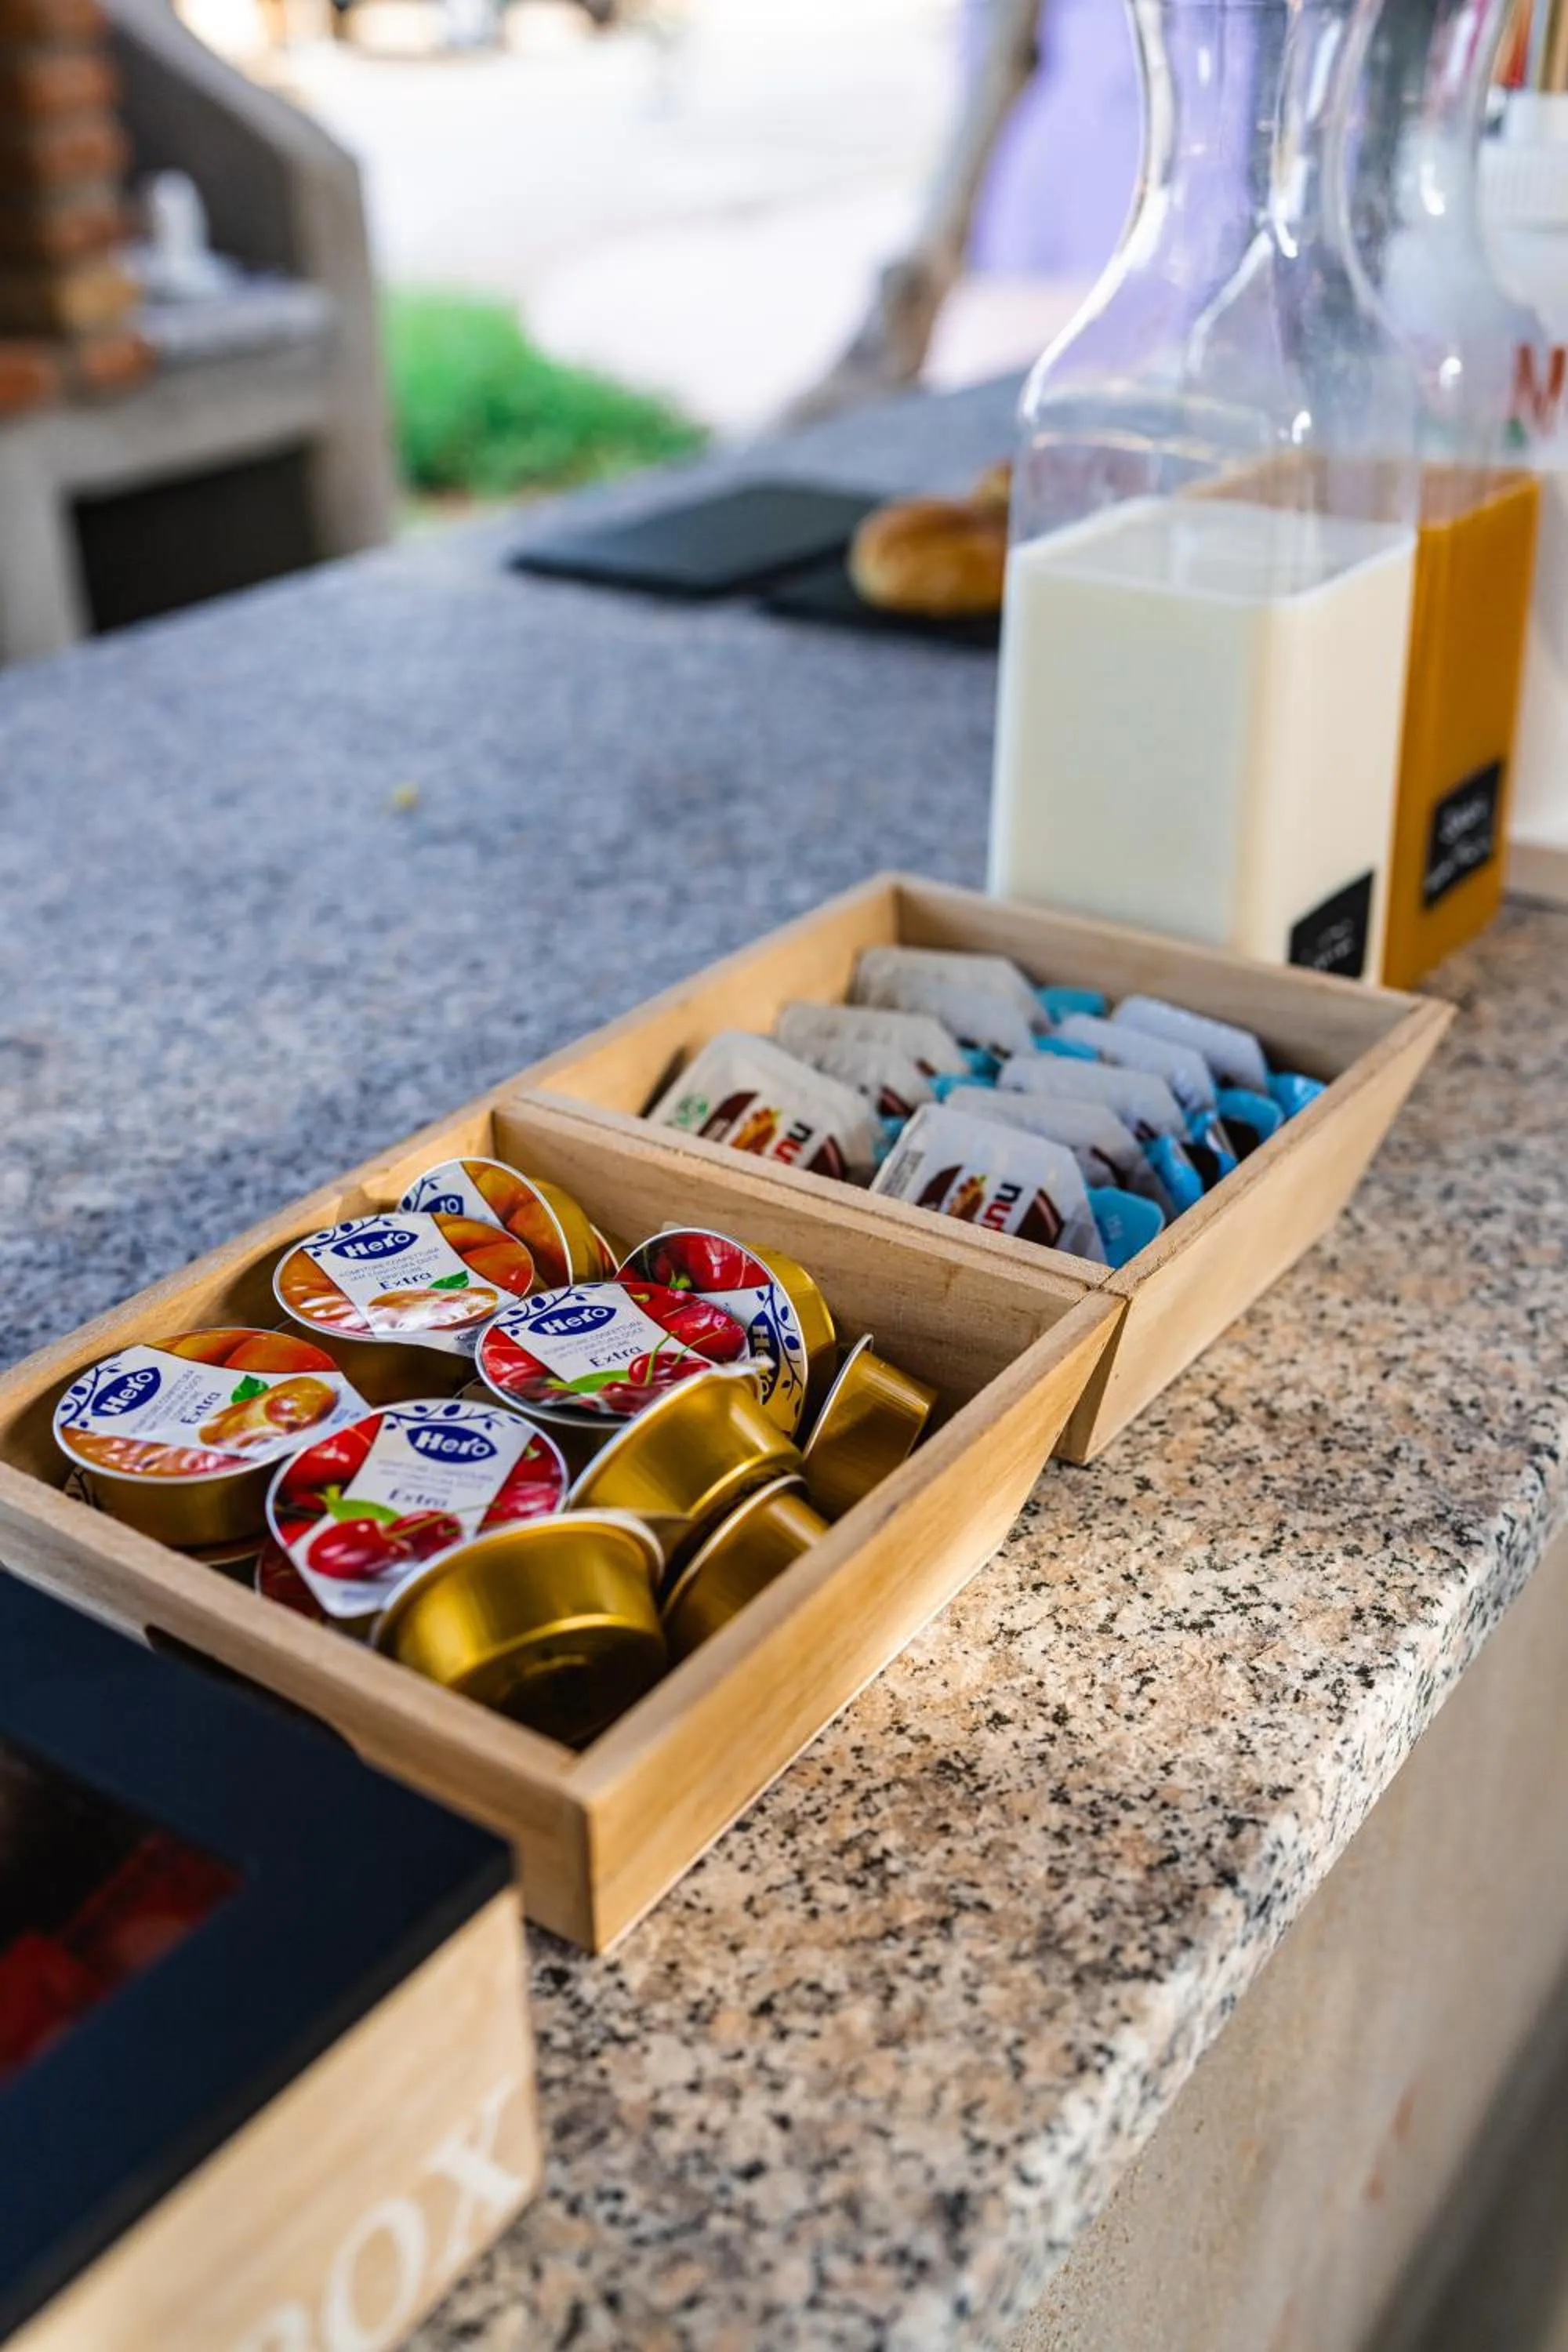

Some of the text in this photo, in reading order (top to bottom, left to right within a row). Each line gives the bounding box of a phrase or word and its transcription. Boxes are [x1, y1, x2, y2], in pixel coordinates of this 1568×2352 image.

[343, 1232, 411, 1258] Hero
[379, 1272, 432, 1290] Extra
[540, 1308, 608, 1334] Hero
[590, 1345, 643, 1367] Extra
[752, 1325, 773, 1396] Ho
[102, 1371, 154, 1415] Hero
[180, 1392, 222, 1425] Extra
[415, 1430, 490, 1457] Hero
[387, 1488, 448, 1508] Extra
